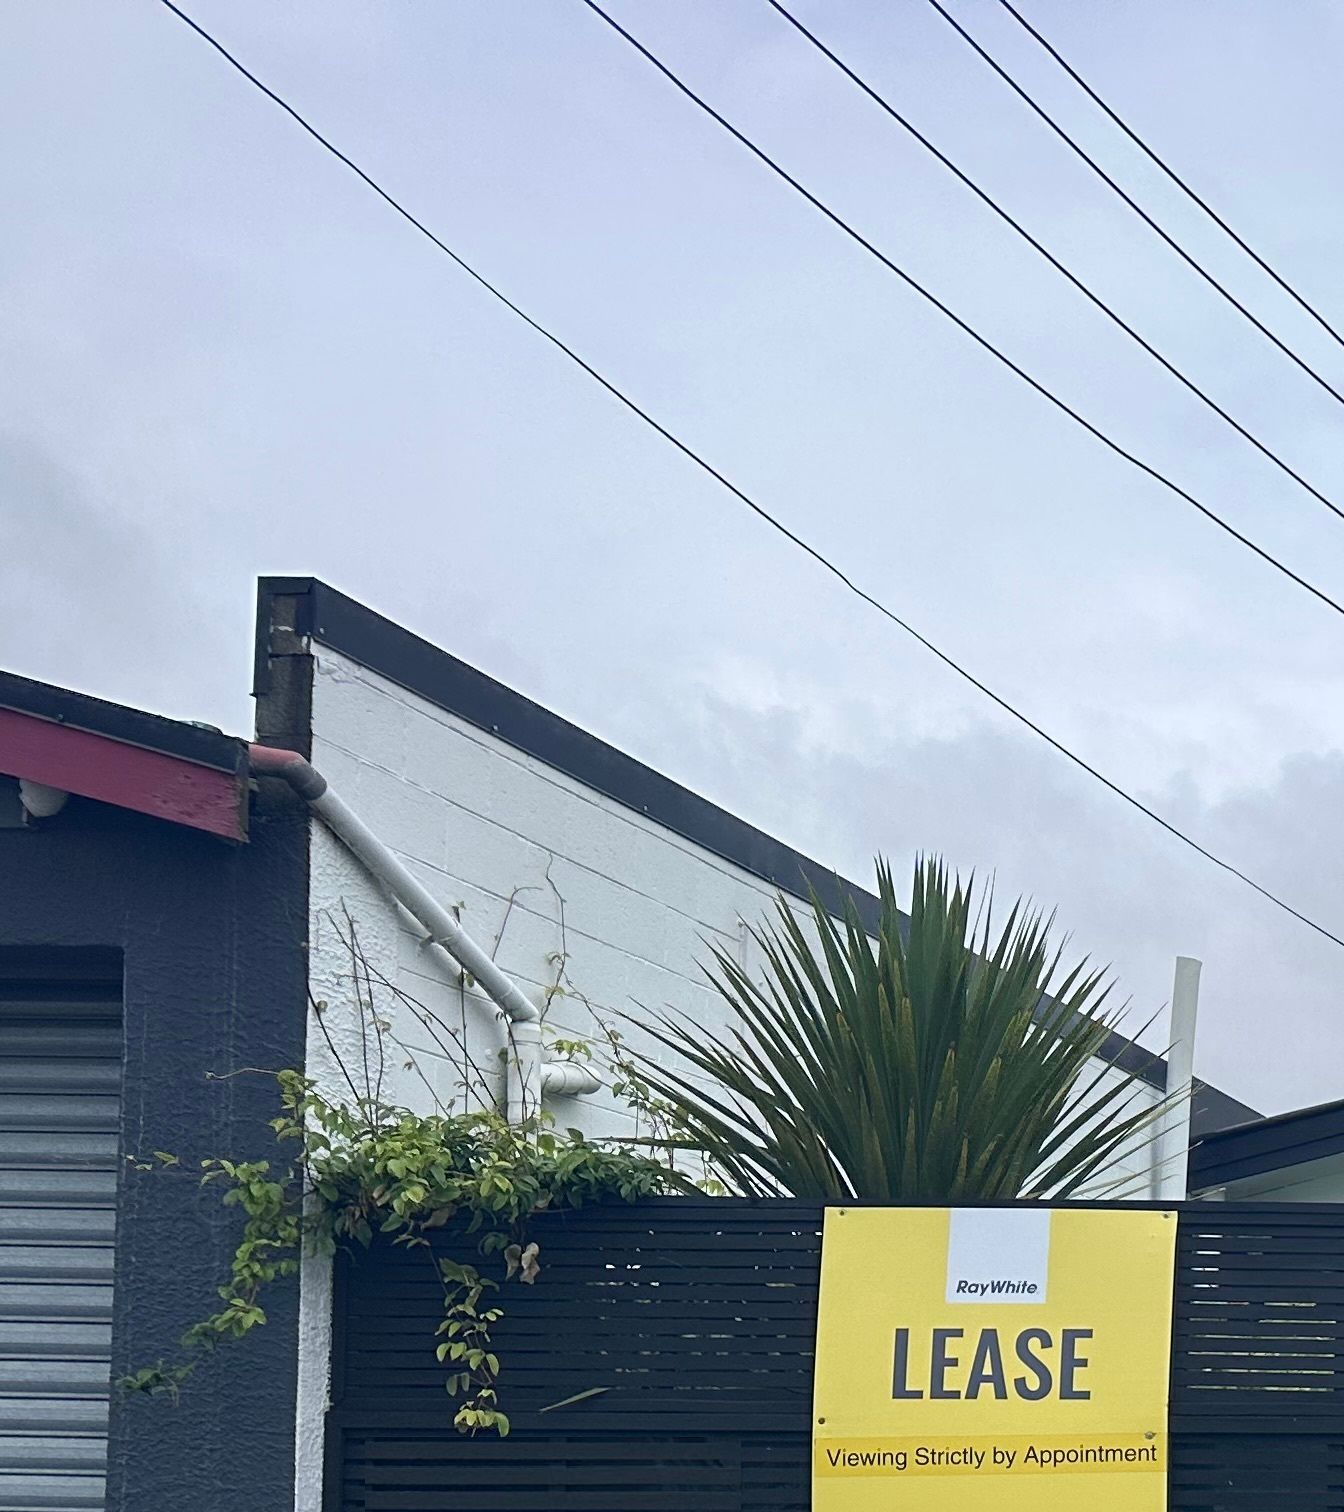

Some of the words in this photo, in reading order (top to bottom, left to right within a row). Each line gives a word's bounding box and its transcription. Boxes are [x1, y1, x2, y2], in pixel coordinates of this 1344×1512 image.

[891, 1328, 1094, 1401] LEASE
[826, 1448, 907, 1470] Viewing
[914, 1446, 986, 1469] Strictly
[992, 1446, 1017, 1468] by
[1024, 1443, 1158, 1467] Appointment
